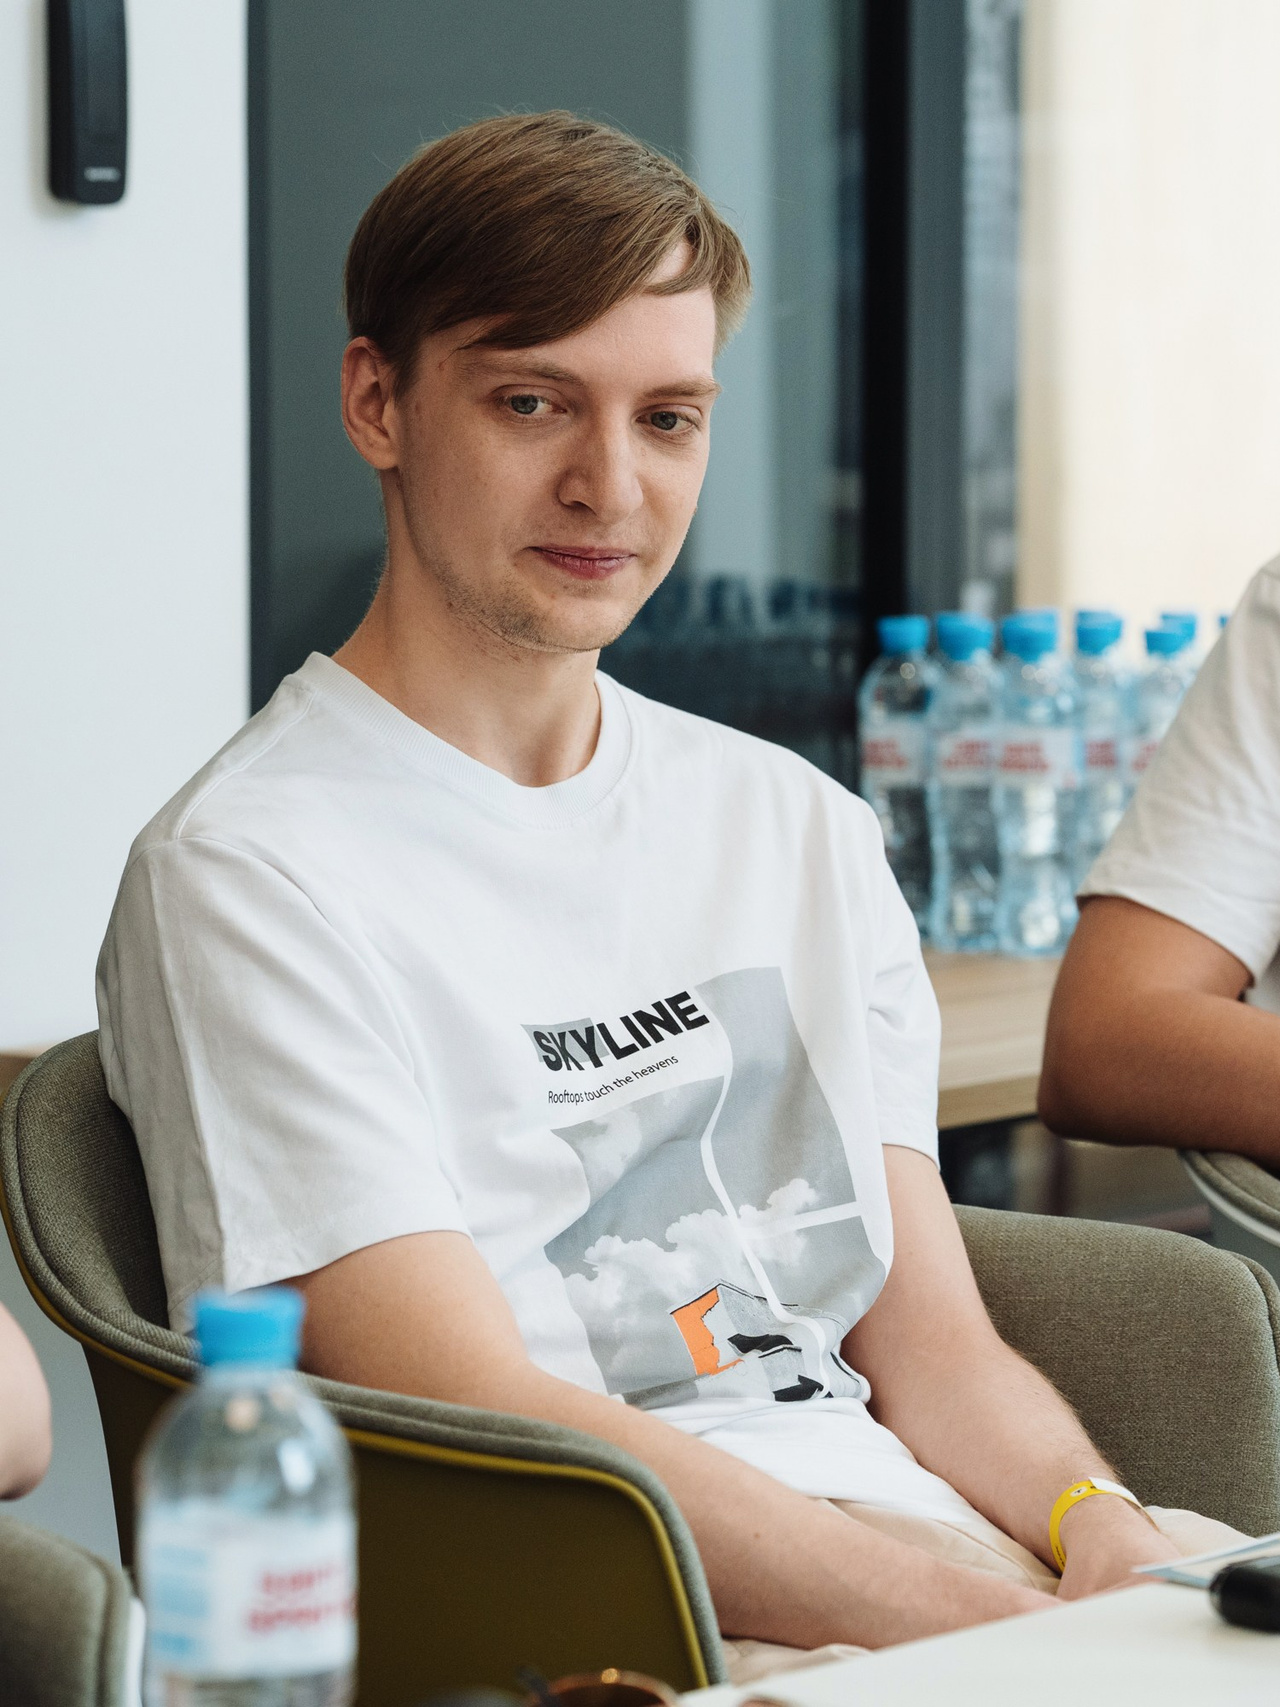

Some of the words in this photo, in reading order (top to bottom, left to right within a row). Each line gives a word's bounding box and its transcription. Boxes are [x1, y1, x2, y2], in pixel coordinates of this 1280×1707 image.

[533, 990, 710, 1072] SKYLINE
[548, 1089, 584, 1106] Rooftops
[584, 1083, 615, 1102] touch
[613, 1073, 634, 1088] the
[631, 1055, 679, 1080] heavens
